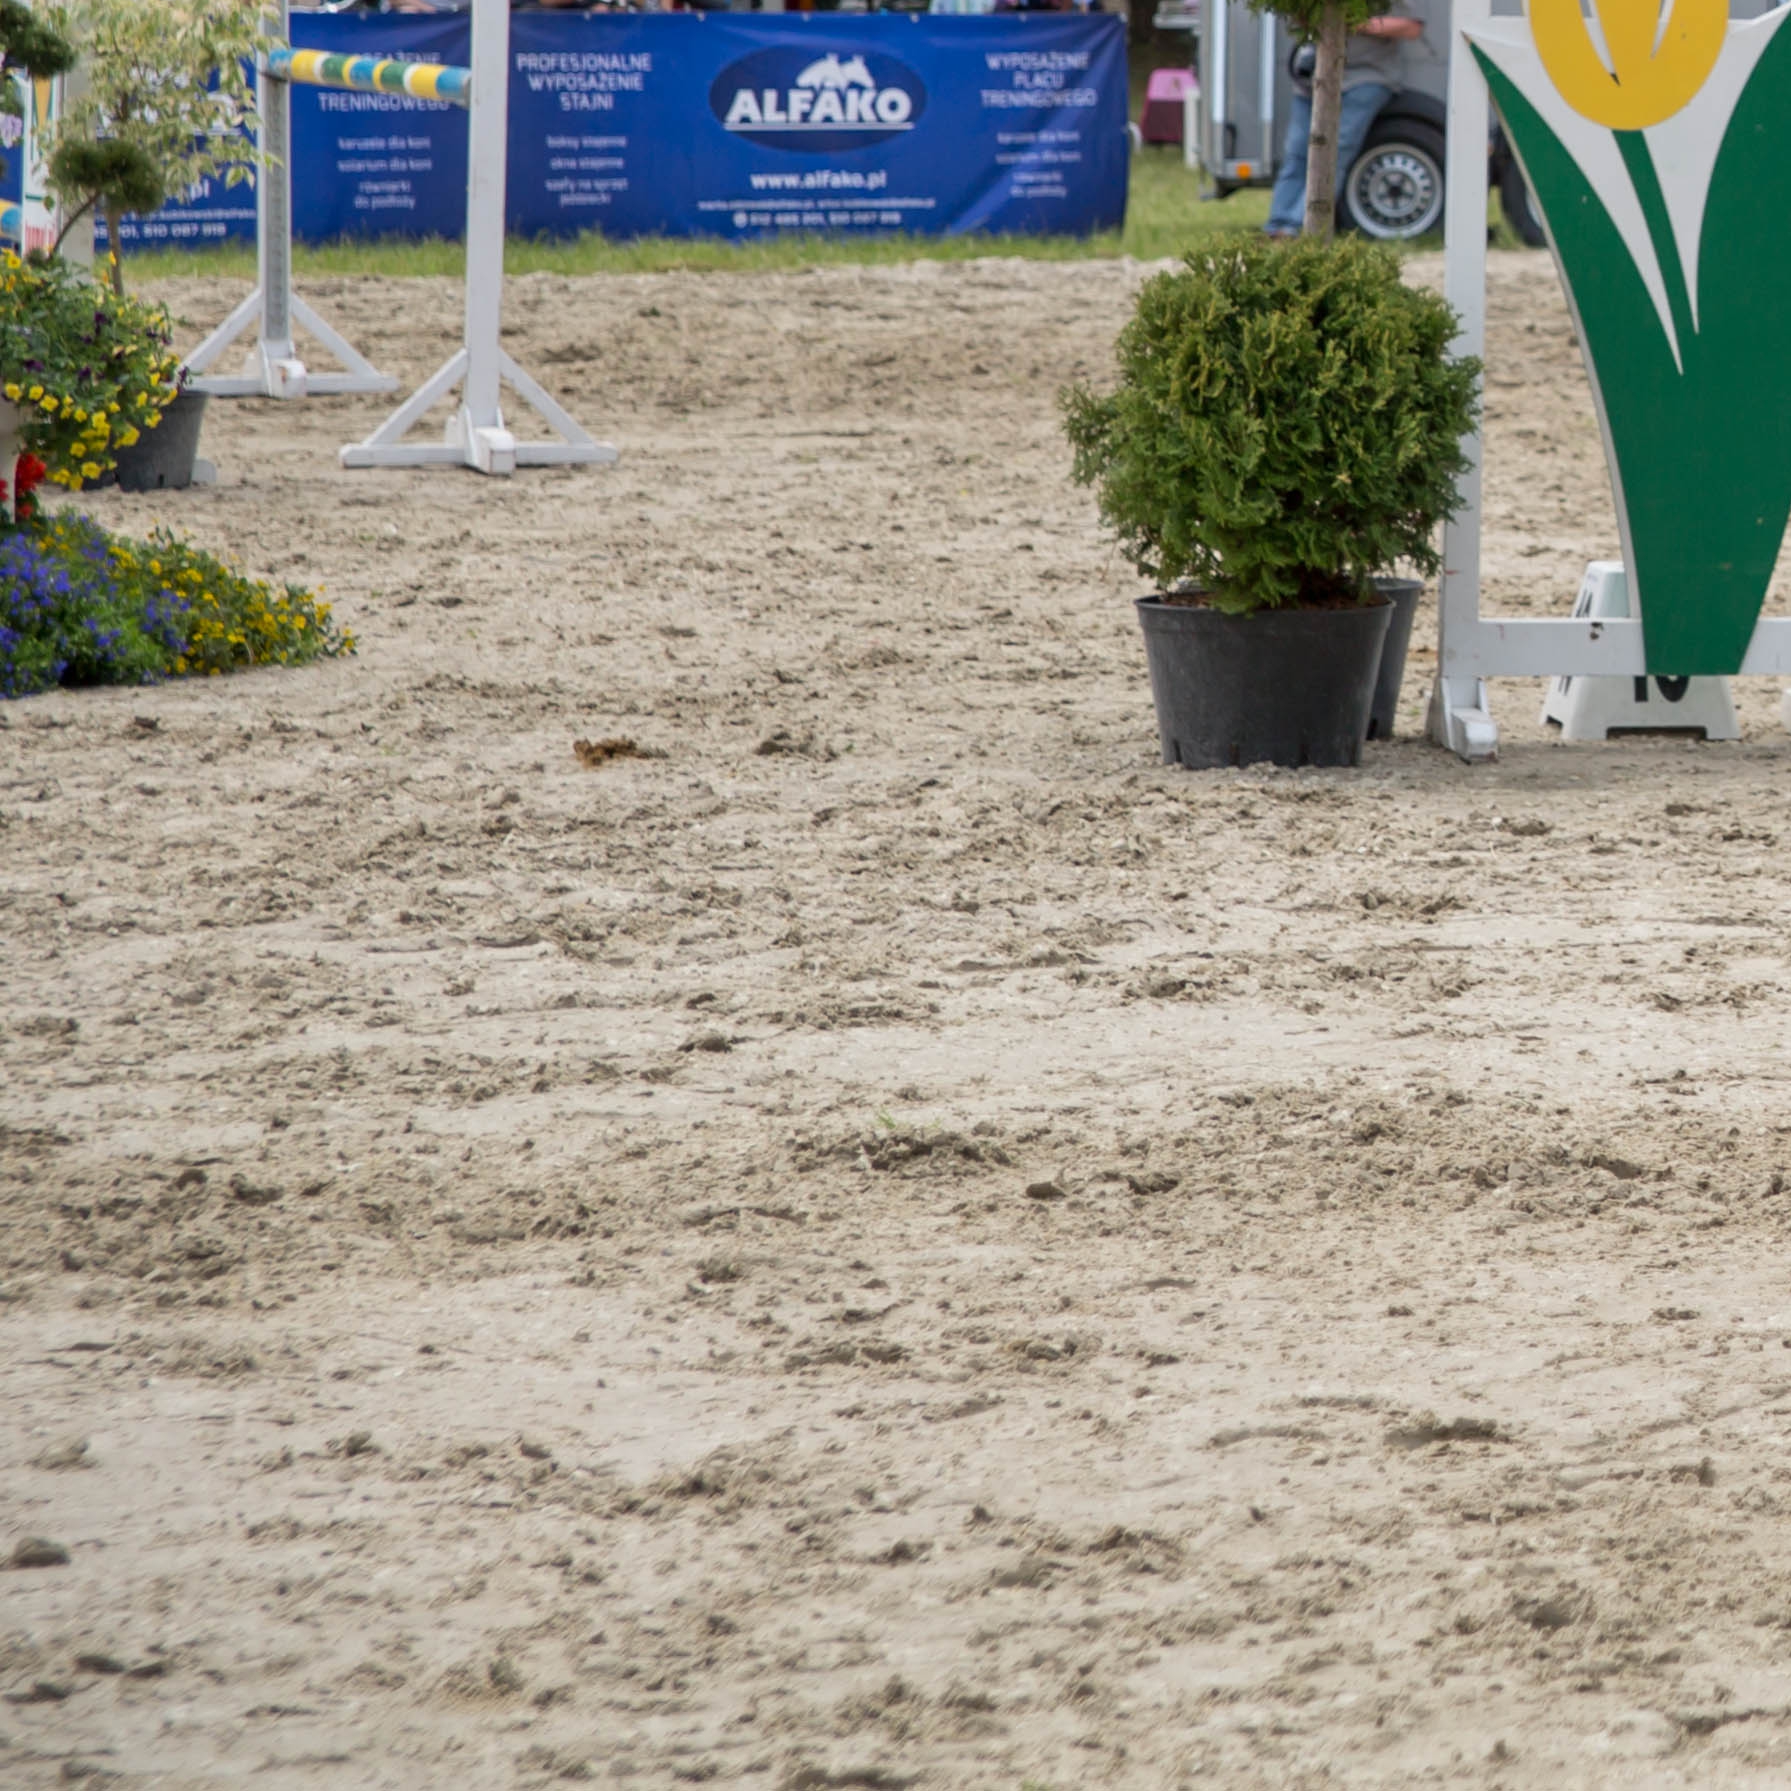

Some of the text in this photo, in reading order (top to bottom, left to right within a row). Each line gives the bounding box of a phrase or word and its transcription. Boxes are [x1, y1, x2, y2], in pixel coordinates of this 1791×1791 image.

[516, 52, 652, 72] PROFESJONALNE
[559, 92, 614, 111] STAJNI
[724, 87, 913, 124] ALFAKO
[749, 169, 887, 190] www.alfako.pl
